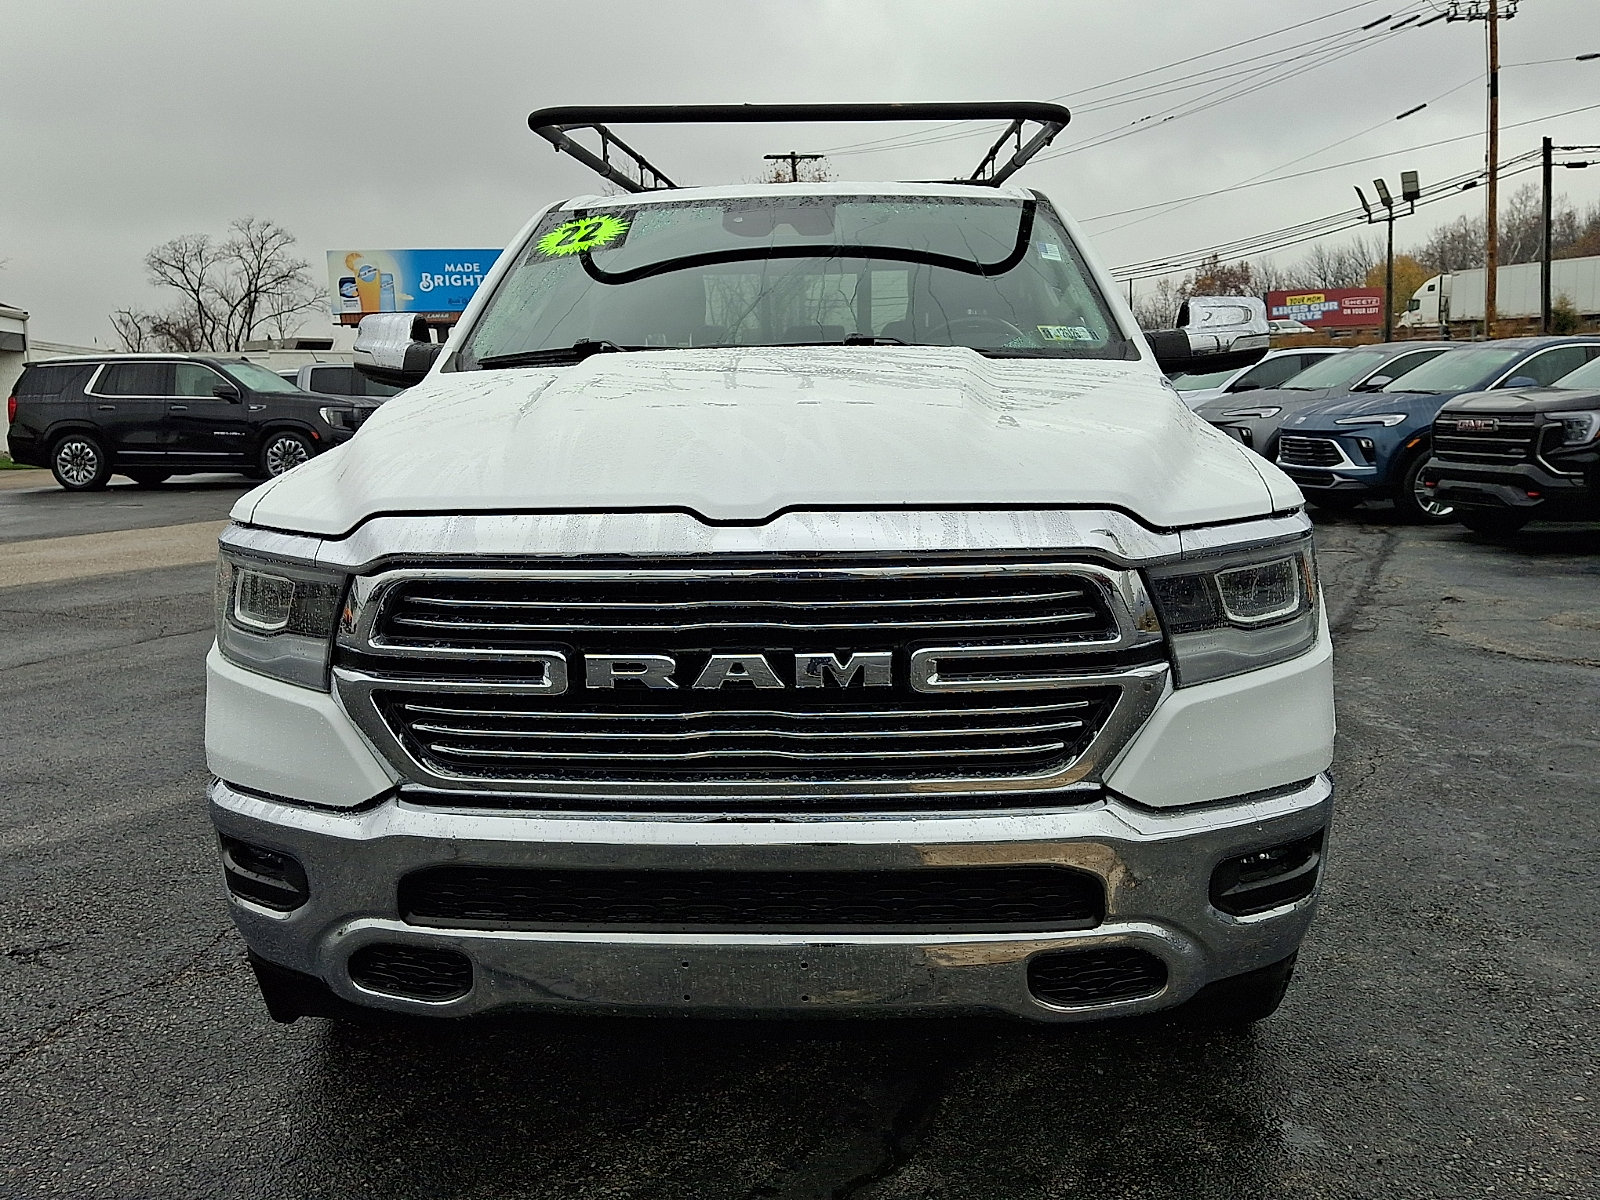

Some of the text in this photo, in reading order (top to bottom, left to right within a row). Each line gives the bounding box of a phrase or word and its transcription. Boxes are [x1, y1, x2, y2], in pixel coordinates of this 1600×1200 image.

[444, 262, 481, 273] MADE
[419, 272, 487, 292] BRIGHT
[1272, 301, 1339, 316] LIKES OUR
[1343, 298, 1379, 306] SHEETZ
[584, 652, 893, 689] RAM
